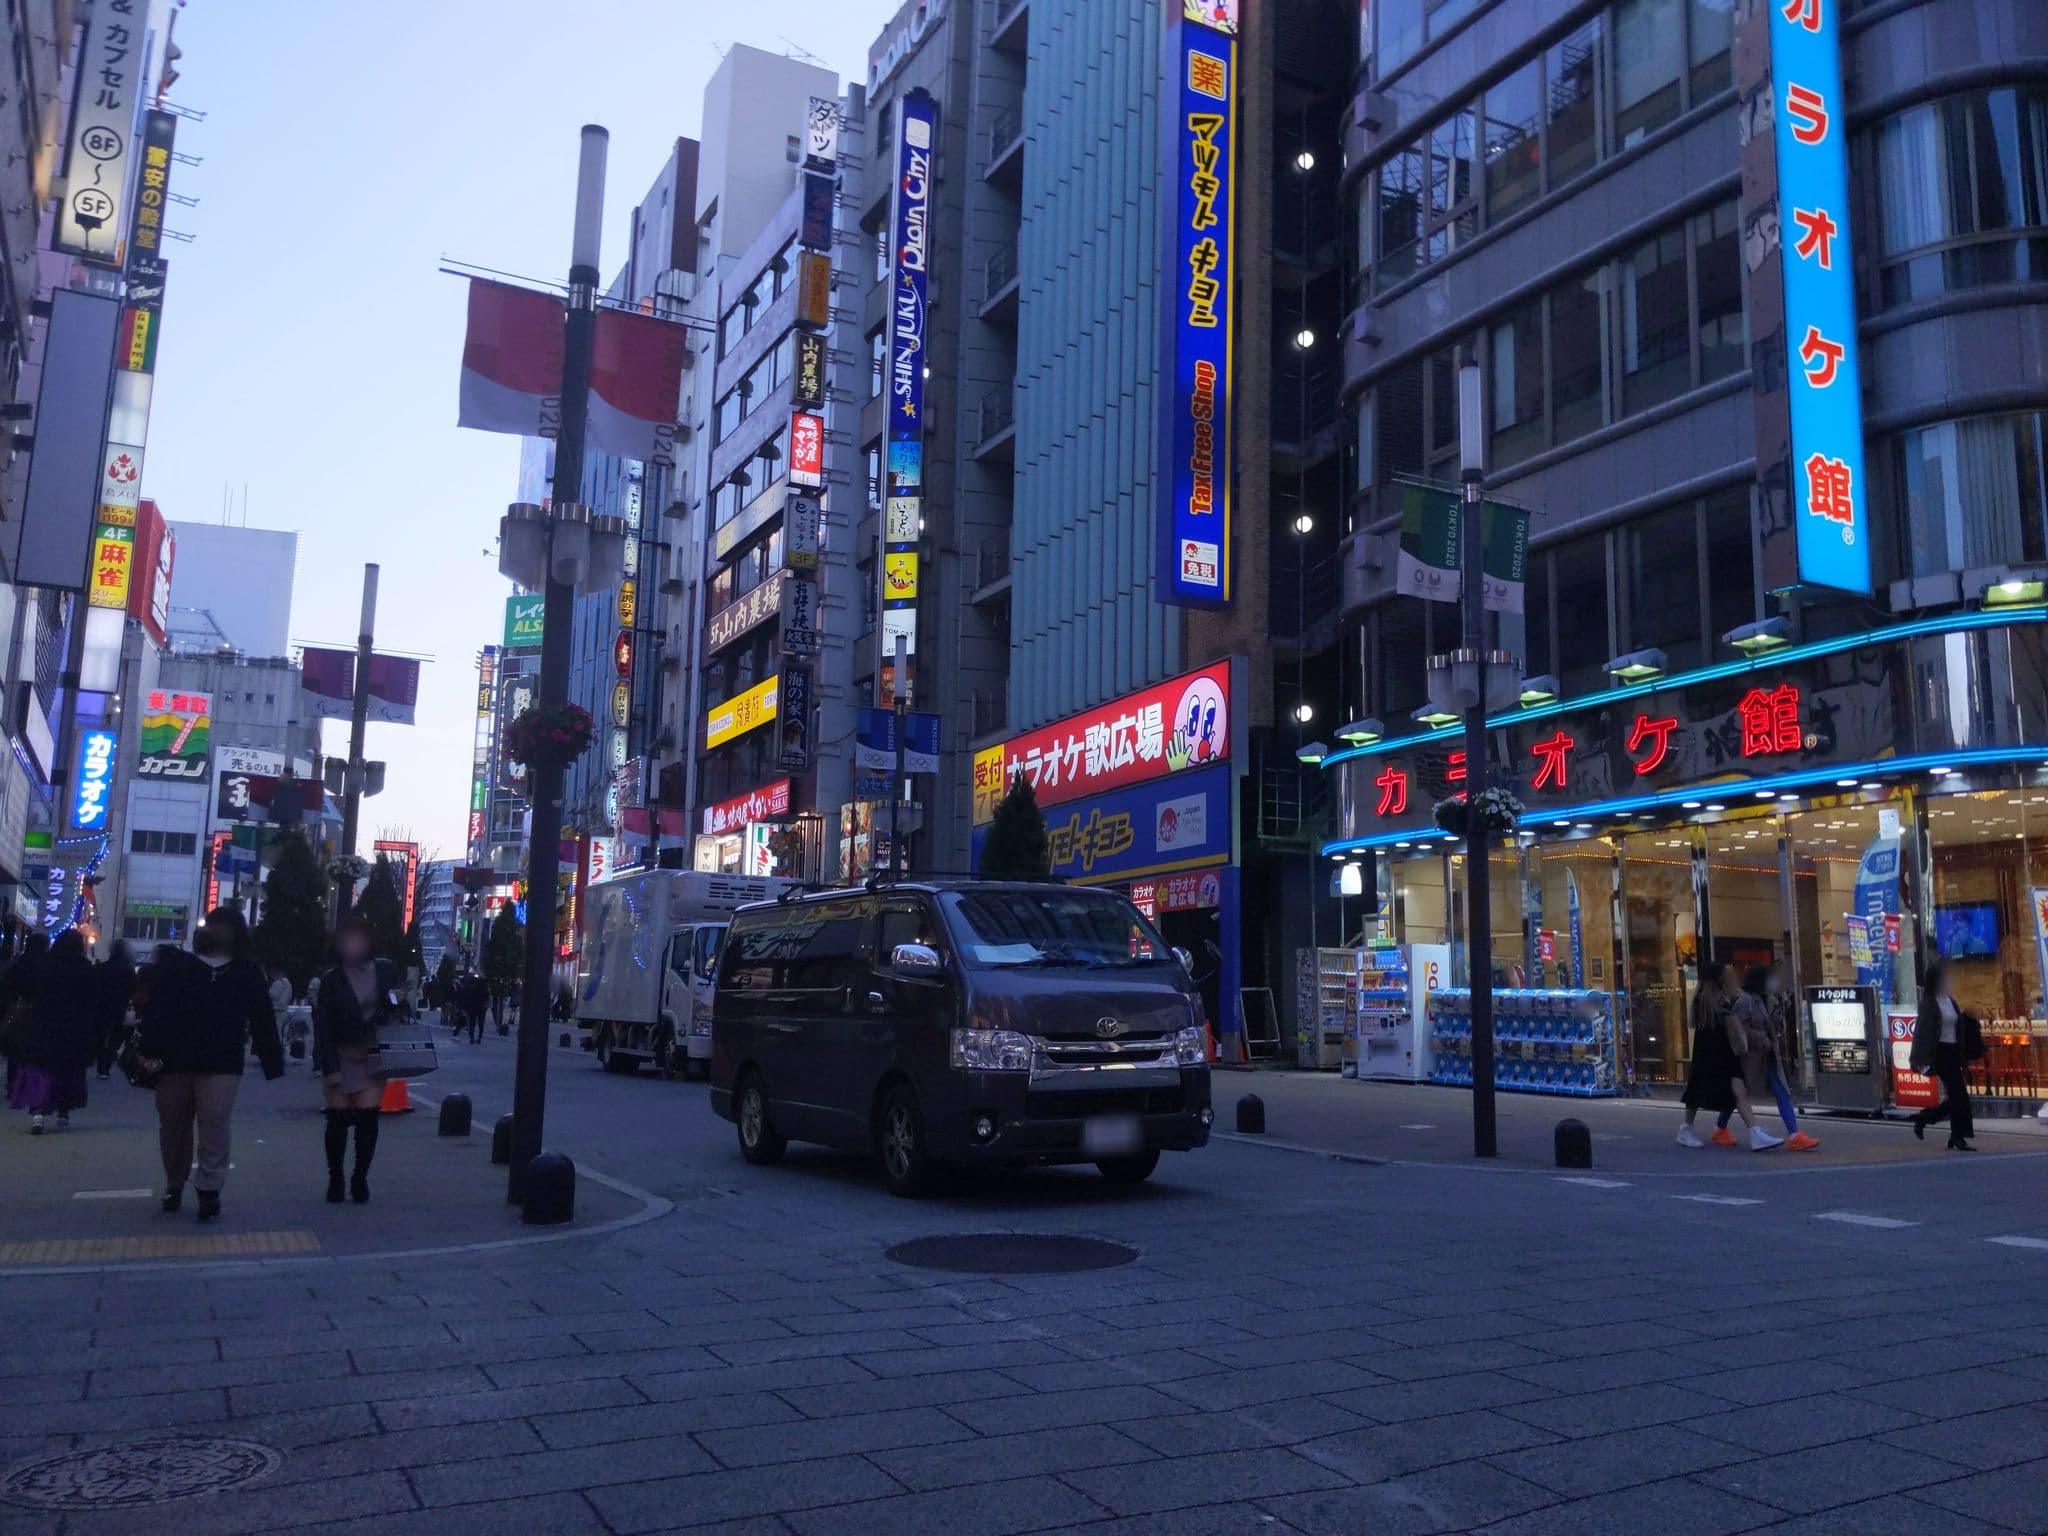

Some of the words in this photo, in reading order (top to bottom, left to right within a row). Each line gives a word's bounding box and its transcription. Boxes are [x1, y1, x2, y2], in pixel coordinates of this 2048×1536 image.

[1192, 56, 1221, 94] 薬
[89, 134, 115, 153] 8F
[814, 105, 831, 151] ダーツ
[80, 196, 106, 215] 5F
[136, 144, 168, 249] 驚安の殿堂
[894, 288, 921, 396] SHINJUKU
[800, 337, 820, 393] 山内農場
[1191, 359, 1217, 421] Shop
[1191, 419, 1215, 476] Free
[103, 505, 133, 516] 生ビール
[1190, 476, 1213, 516] Tax
[103, 527, 128, 541] 4F
[1448, 504, 1459, 538] TOKYO
[1514, 518, 1526, 553] TOKYO
[98, 543, 127, 588] 麻雀
[795, 553, 811, 565] 3F
[1187, 560, 1215, 578] 免税
[1446, 538, 1457, 567] 2020
[1511, 552, 1523, 579] 2020
[719, 578, 782, 644] 山内農場
[1006, 702, 1164, 796] カラオケ歌広場
[78, 734, 113, 824] カラオケ
[138, 756, 207, 777] カワノ
[975, 755, 1003, 788] 受付
[1183, 806, 1201, 816] Japan
[44, 867, 65, 928] カラオケ
[1133, 885, 1154, 899] カラオケ
[1168, 878, 1196, 893] カラオケ
[1168, 890, 1196, 906] 歌広場
